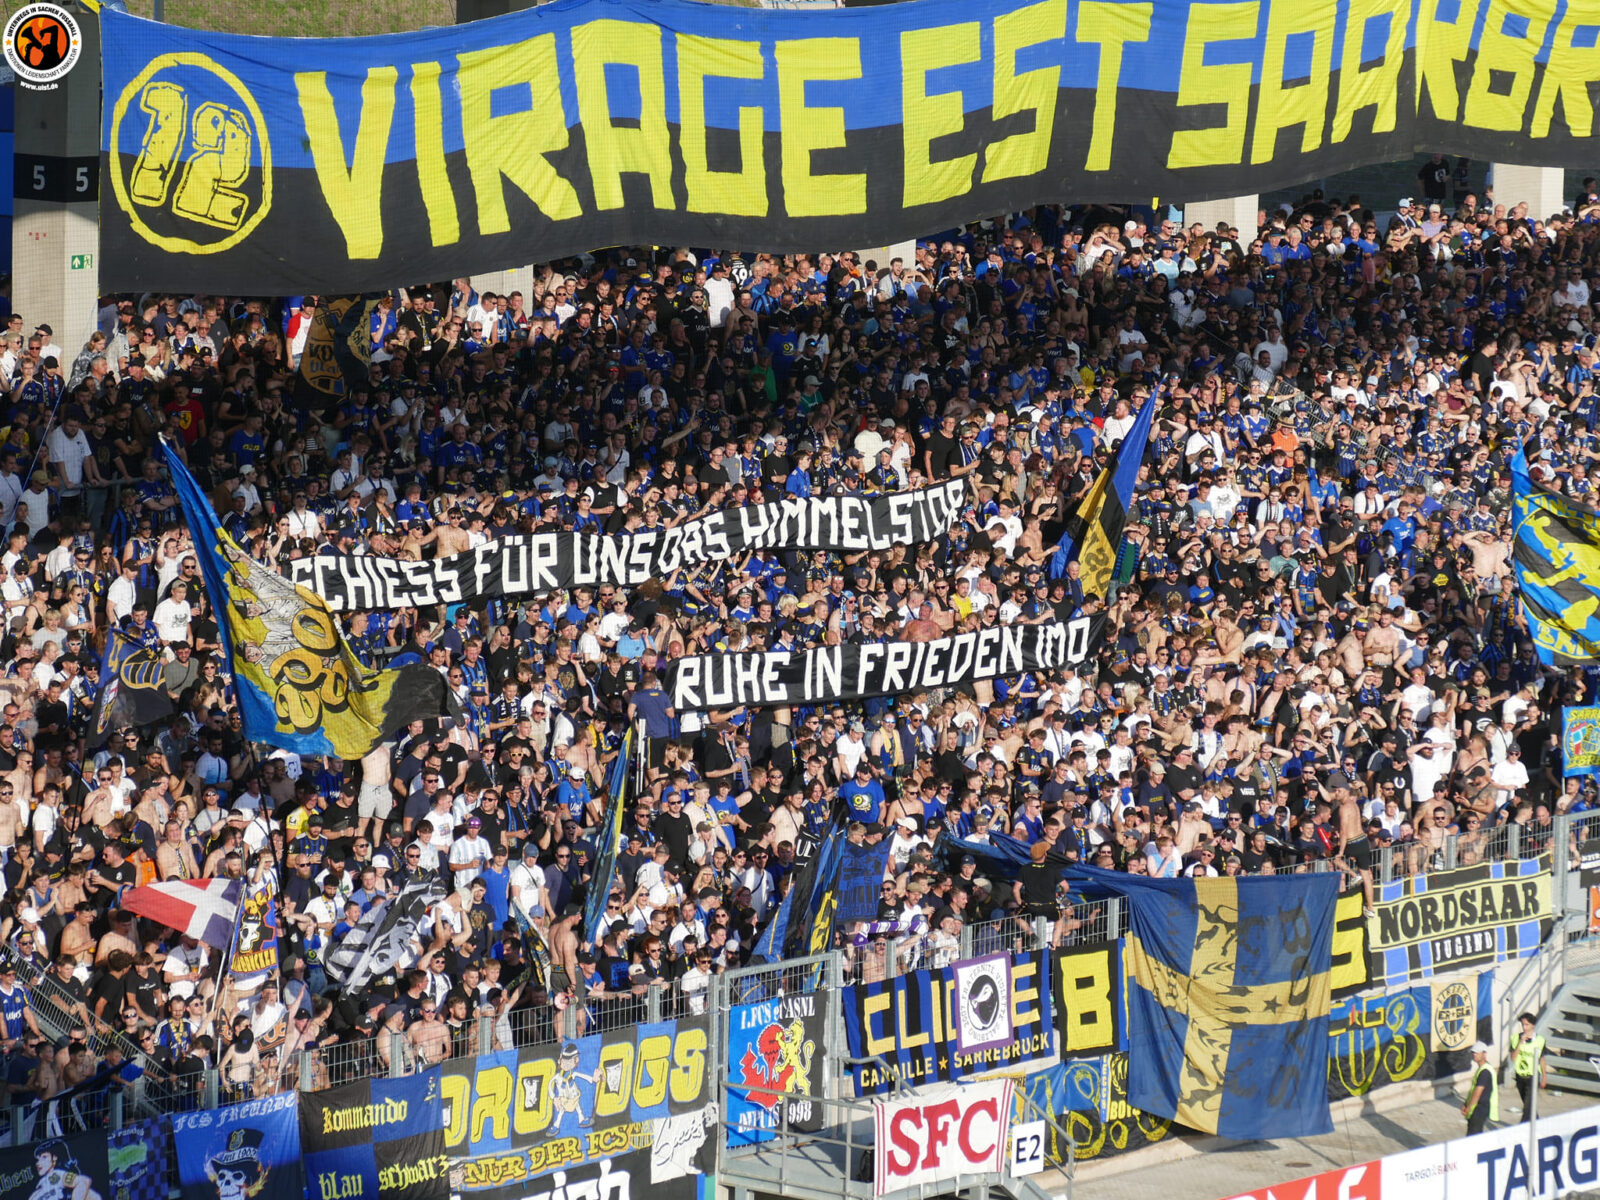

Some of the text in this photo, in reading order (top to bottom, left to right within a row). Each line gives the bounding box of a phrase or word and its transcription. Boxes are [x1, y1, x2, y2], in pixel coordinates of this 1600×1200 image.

[294, 19, 867, 259] VIRAGE
[901, 1, 1153, 208] EST
[33, 165, 89, 193] 5 5
[291, 554, 463, 610] SCHIESS
[474, 533, 559, 596] FÜR
[573, 531, 657, 586] UNS
[674, 616, 1091, 709] RUHE IN FRIEDEN IMO
[1377, 881, 1541, 944] NORDSAAR
[1434, 930, 1494, 962] JUGEND
[863, 962, 1041, 1057] CLIE
[953, 1031, 1051, 1069] SARREBRUCK
[174, 1092, 296, 1133] FCS FREUNDE
[786, 1099, 812, 1124] 998
[887, 1097, 999, 1176] SFC
[464, 1154, 526, 1185] NUR
[530, 1136, 582, 1172] DER
[586, 1123, 630, 1154] FCS
[1014, 1134, 1041, 1164] E2
[318, 1171, 364, 1200] blau
[377, 1153, 451, 1192] schwarz
